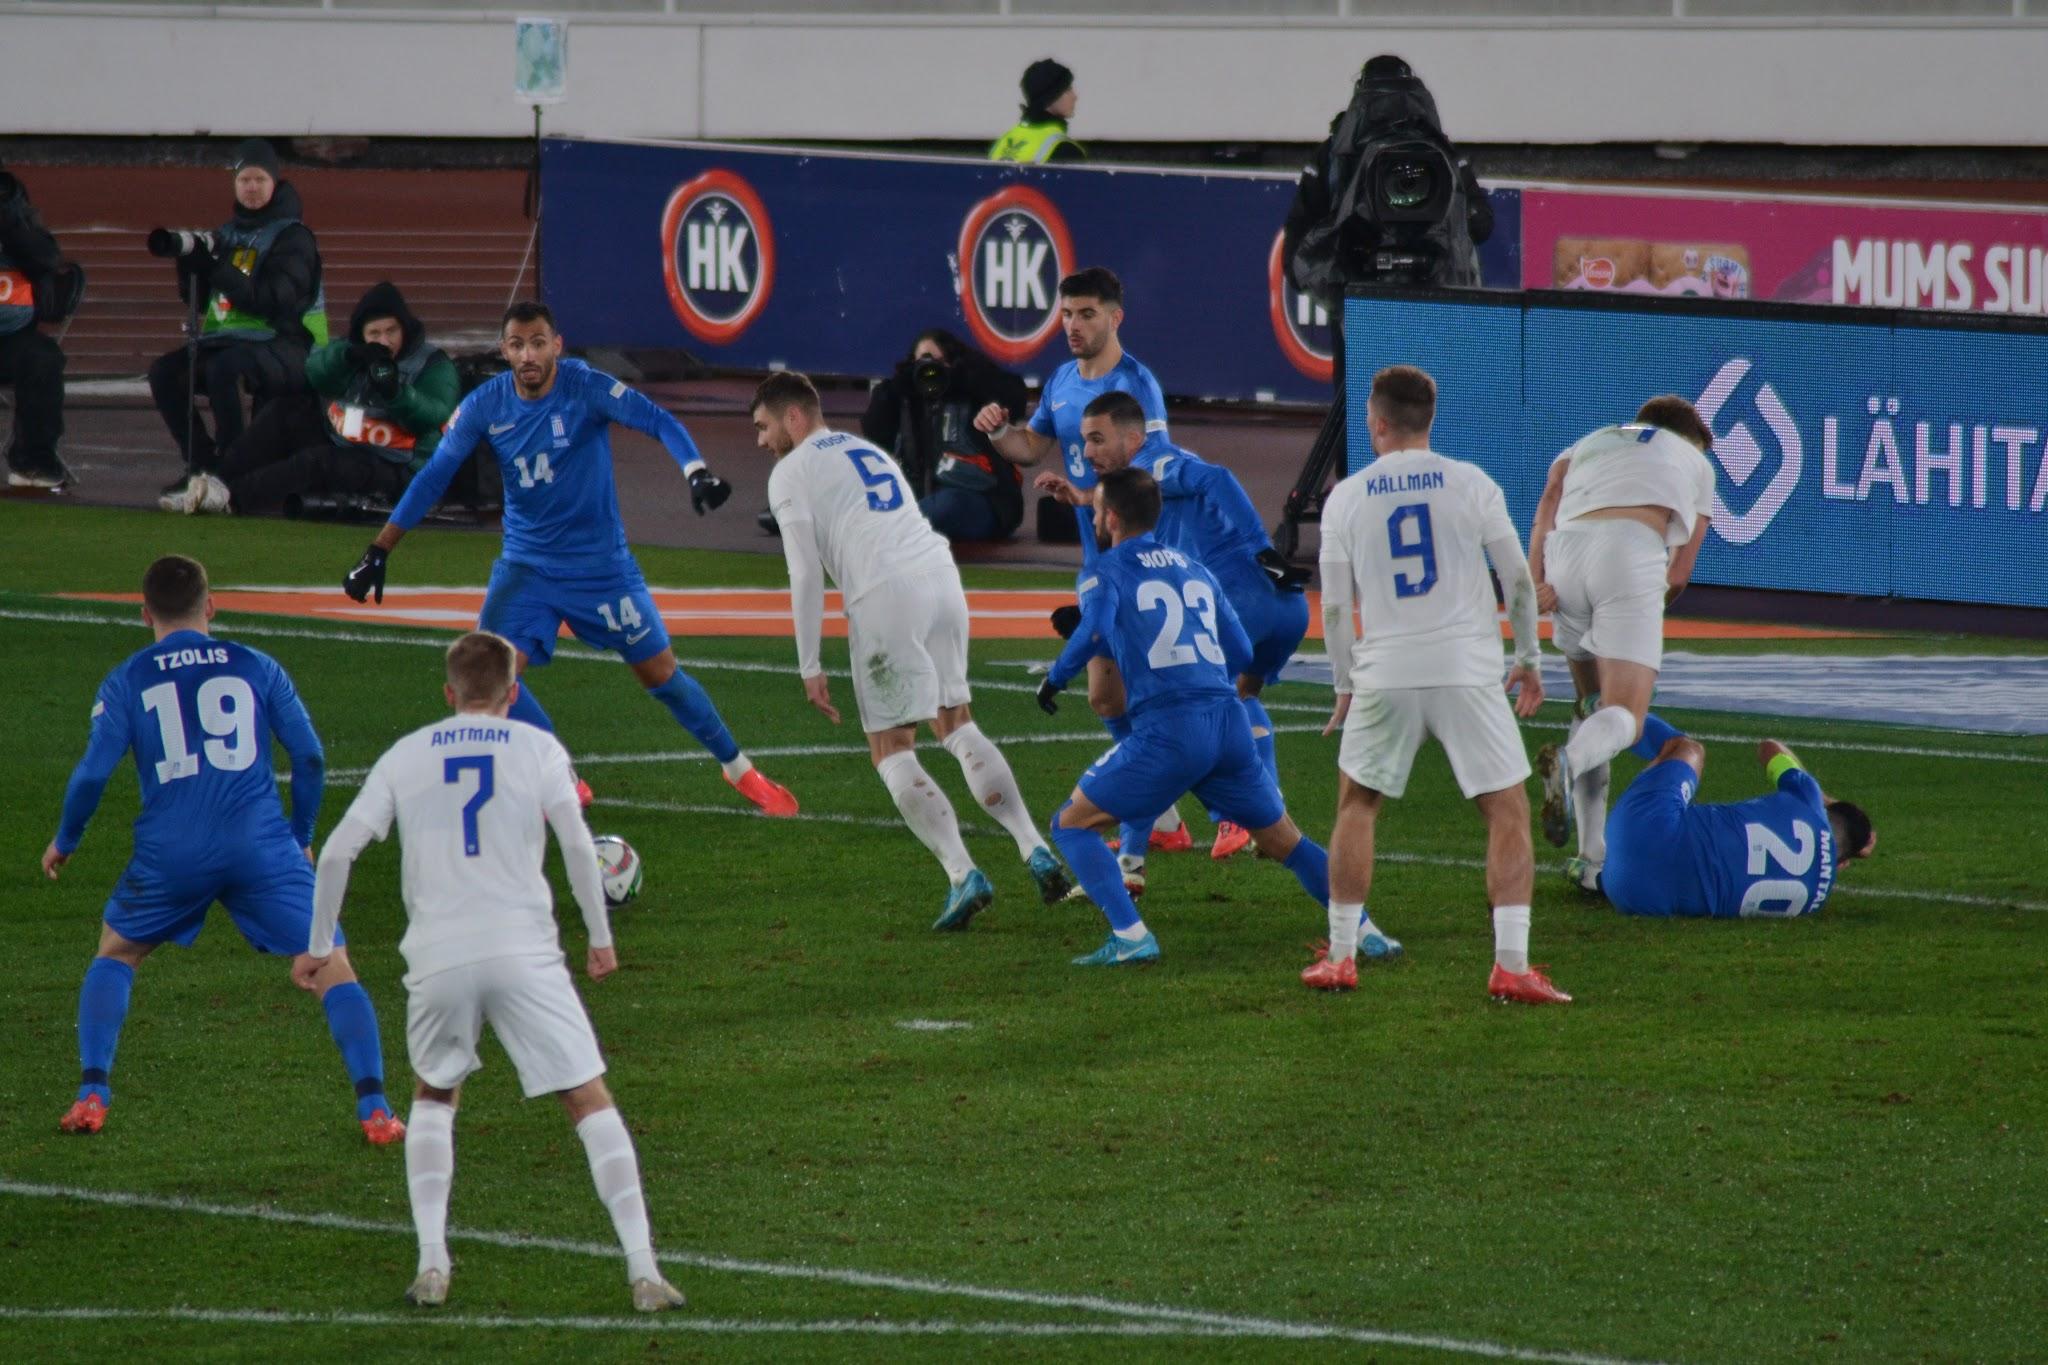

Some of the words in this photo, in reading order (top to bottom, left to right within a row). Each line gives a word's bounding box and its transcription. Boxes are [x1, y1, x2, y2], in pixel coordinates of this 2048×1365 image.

[688, 223, 749, 293] HK
[985, 240, 1049, 310] HK
[1832, 237, 1974, 311] MUMS
[1983, 244, 2048, 314] SU
[514, 452, 555, 489] 14
[845, 448, 904, 512] 5
[1069, 443, 1085, 478] 3
[1366, 471, 1444, 497] KÄLLMAN
[1387, 502, 1438, 600] 9
[597, 595, 642, 633] 14
[1136, 579, 1226, 670] 23
[153, 647, 229, 671] TZOLIS
[141, 675, 257, 785] 19
[431, 727, 510, 747] ANTMAN
[444, 754, 494, 857] 7
[1739, 818, 1816, 918] 20
